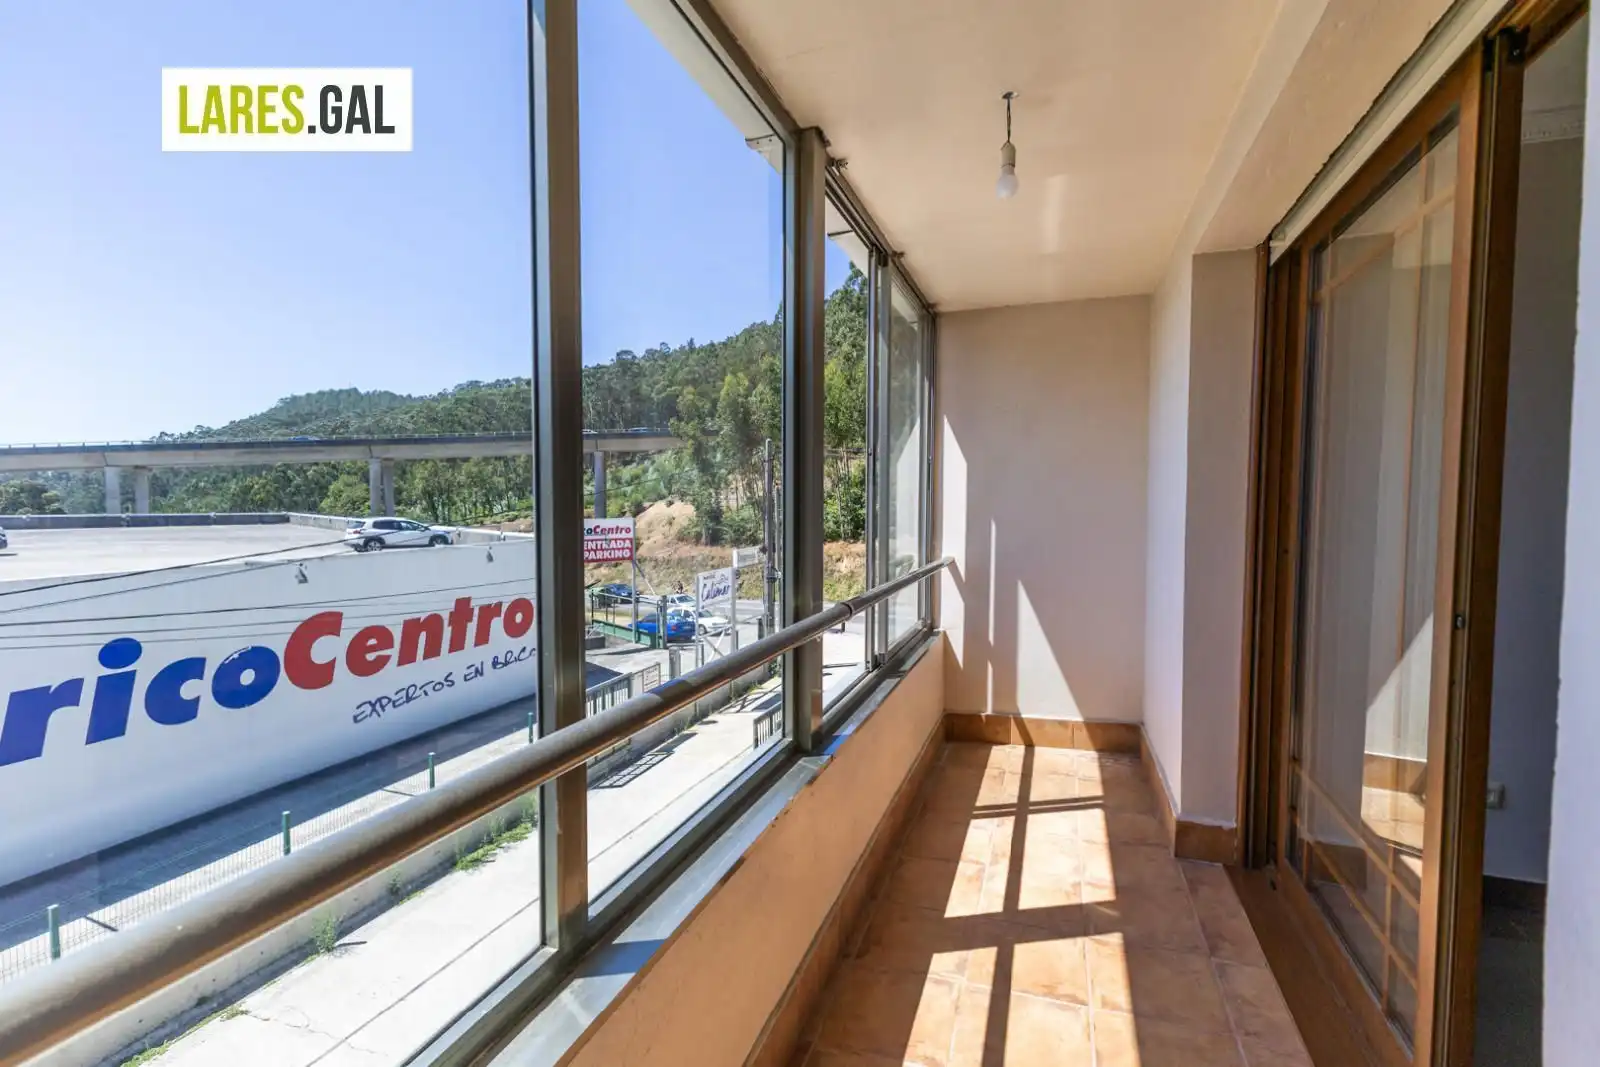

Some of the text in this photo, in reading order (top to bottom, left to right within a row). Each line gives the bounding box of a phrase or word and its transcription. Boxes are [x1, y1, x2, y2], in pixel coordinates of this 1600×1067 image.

[584, 540, 632, 550] ENTRADA
[584, 549, 631, 560] PARKING
[353, 672, 456, 724] EXPERTOS
[464, 661, 484, 682] EN
